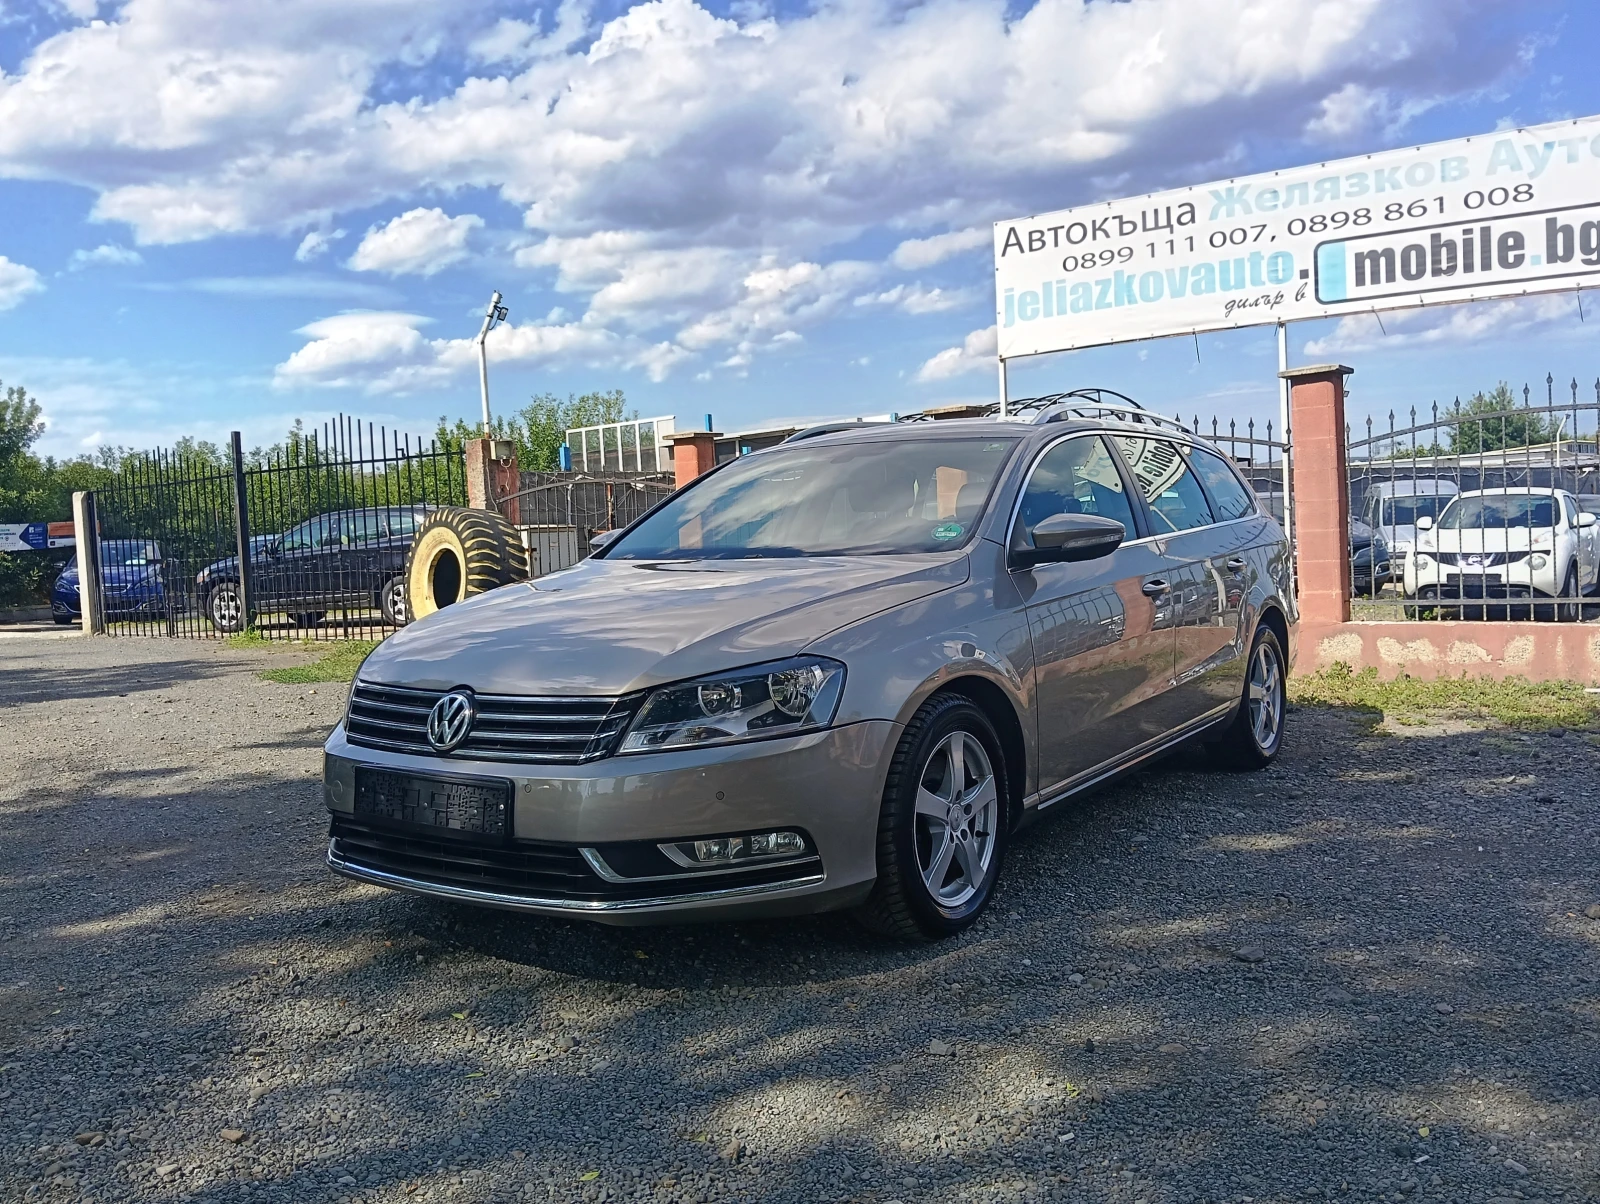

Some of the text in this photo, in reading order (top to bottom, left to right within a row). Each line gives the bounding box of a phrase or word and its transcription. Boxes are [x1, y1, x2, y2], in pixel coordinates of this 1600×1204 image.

[1001, 202, 1196, 258] Автокъща
[1208, 156, 1470, 221] Желязков
[1062, 183, 1534, 272] 0899 111 007, 0898 861 008
[1354, 217, 1600, 287] mobile.bg
[1224, 282, 1309, 318] дилър в
[427, 693, 470, 749] VW
